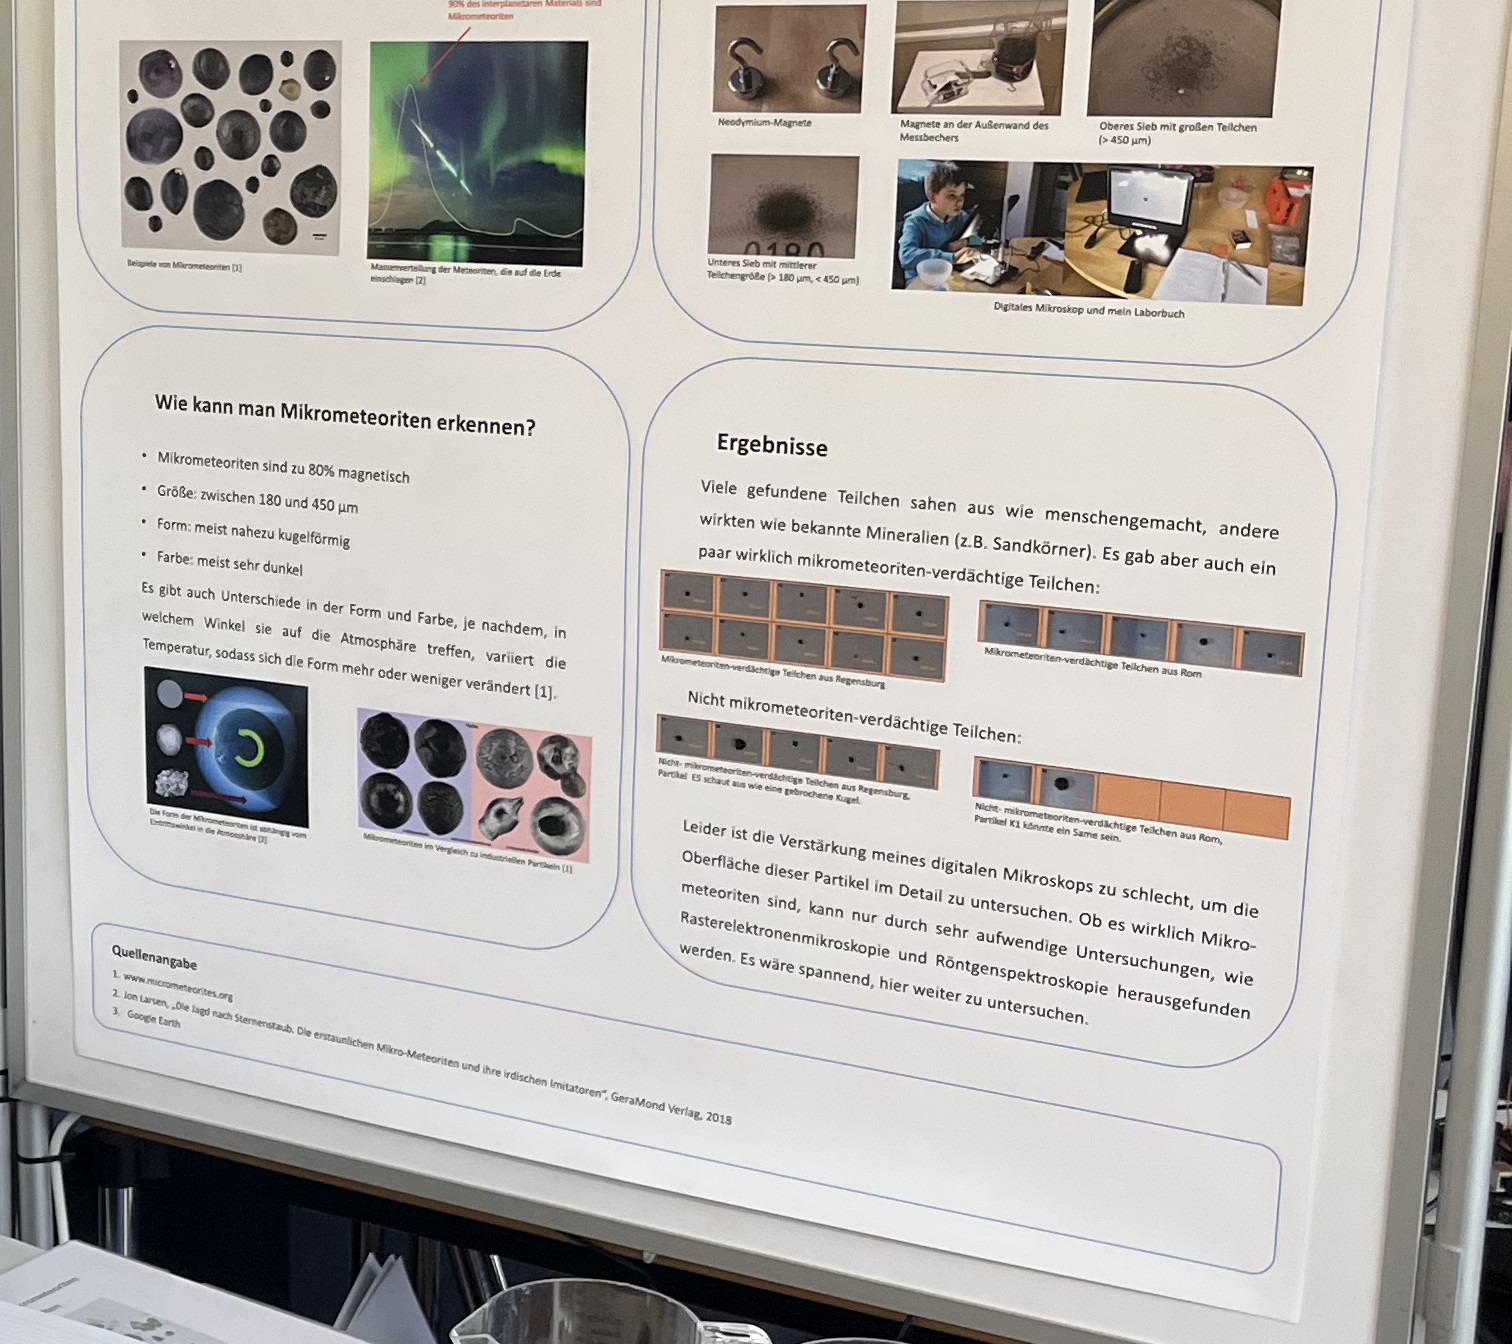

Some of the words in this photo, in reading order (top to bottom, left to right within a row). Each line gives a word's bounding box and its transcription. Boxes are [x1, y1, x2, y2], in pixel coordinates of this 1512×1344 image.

[993, 301, 1033, 313] Digitales
[1035, 303, 1085, 316] Mikroskop
[1086, 305, 1106, 316] und
[1107, 306, 1132, 317] mein
[1134, 307, 1185, 319] Laborbuch
[154, 393, 188, 412] Wie
[193, 395, 233, 415] kann
[238, 402, 275, 418] man
[281, 402, 432, 430] Mikrometeoriten
[436, 413, 536, 437] erkennen?
[717, 432, 828, 458] Ergebnisse
[157, 450, 260, 471] Mikrometeoriten
[262, 459, 288, 474] sind
[291, 464, 305, 475] zu
[308, 463, 335, 478] 80%
[338, 468, 410, 484] magnetisch
[700, 479, 738, 495] Viele
[746, 483, 828, 502] gefundene
[837, 489, 900, 508] Teilchen
[910, 495, 957, 513] sahen
[967, 503, 995, 516] aus
[1005, 503, 1034, 519] wie
[1045, 509, 1207, 536] menschengemacht,
[1219, 522, 1280, 540] andere
[688, 690, 726, 708] Nicht
[729, 696, 949, 737] mikrometeoriten-verdächtige
[952, 722, 1022, 745] Teilchen:
[683, 819, 727, 837] Leider
[731, 825, 748, 841] ist
[752, 829, 775, 845] die
[779, 833, 867, 862] Verstärkung
[871, 850, 926, 868] meines
[931, 856, 997, 879] digitalen
[1003, 866, 1094, 895] Mikroskops
[1098, 884, 1117, 897] zu
[1122, 886, 1194, 911] schlecht,
[1200, 899, 1227, 914] um
[1233, 901, 1259, 919] die
[111, 944, 198, 971] Quellenangabe
[680, 910, 891, 959] Rasterelektronenmikroskopie
[898, 950, 928, 965] und
[935, 953, 1109, 996] Röntgenspektroskopie
[1117, 983, 1251, 1020] herausgefunden
[123, 973, 234, 1004] www.micrometeorites.org
[126, 1009, 157, 1024] Google
[158, 1015, 181, 1029] Earth
